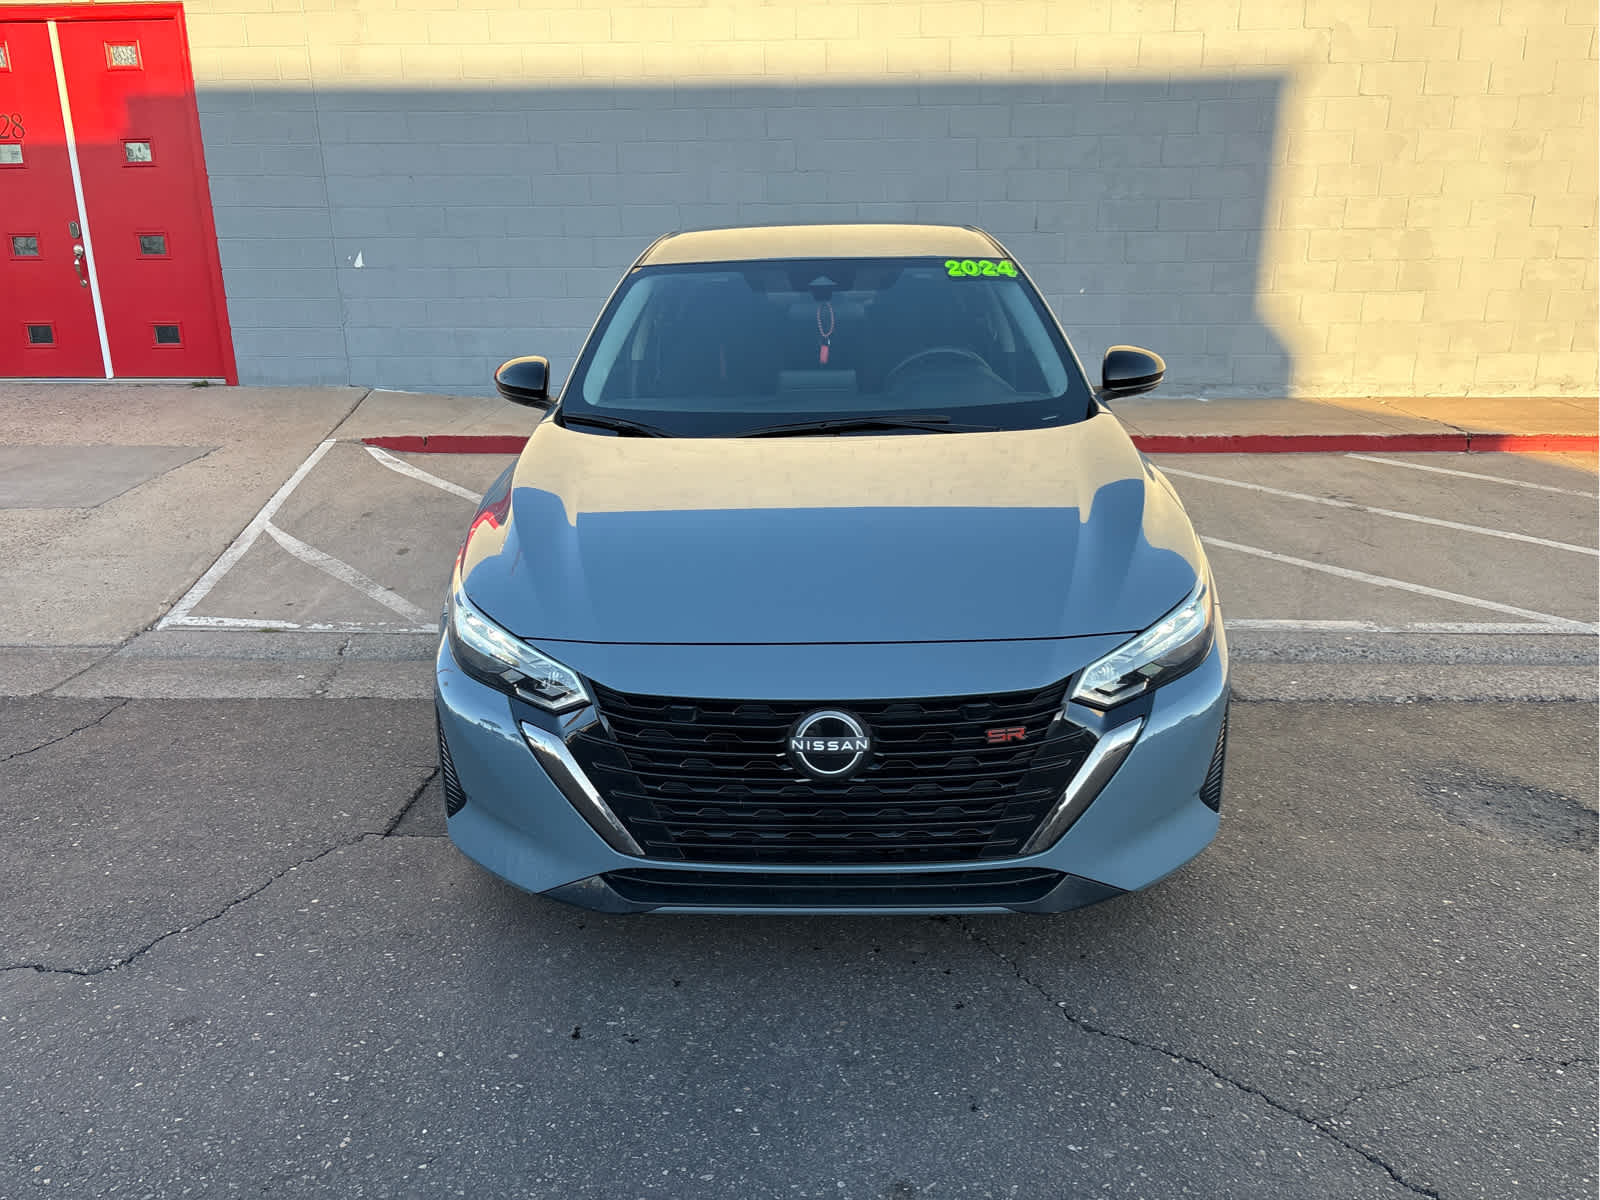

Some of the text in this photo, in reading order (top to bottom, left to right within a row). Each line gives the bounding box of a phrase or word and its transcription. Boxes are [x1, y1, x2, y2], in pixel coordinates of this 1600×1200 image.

[944, 259, 1018, 278] 2024
[986, 726, 1026, 743] SR
[791, 739, 868, 751] NISSAN
